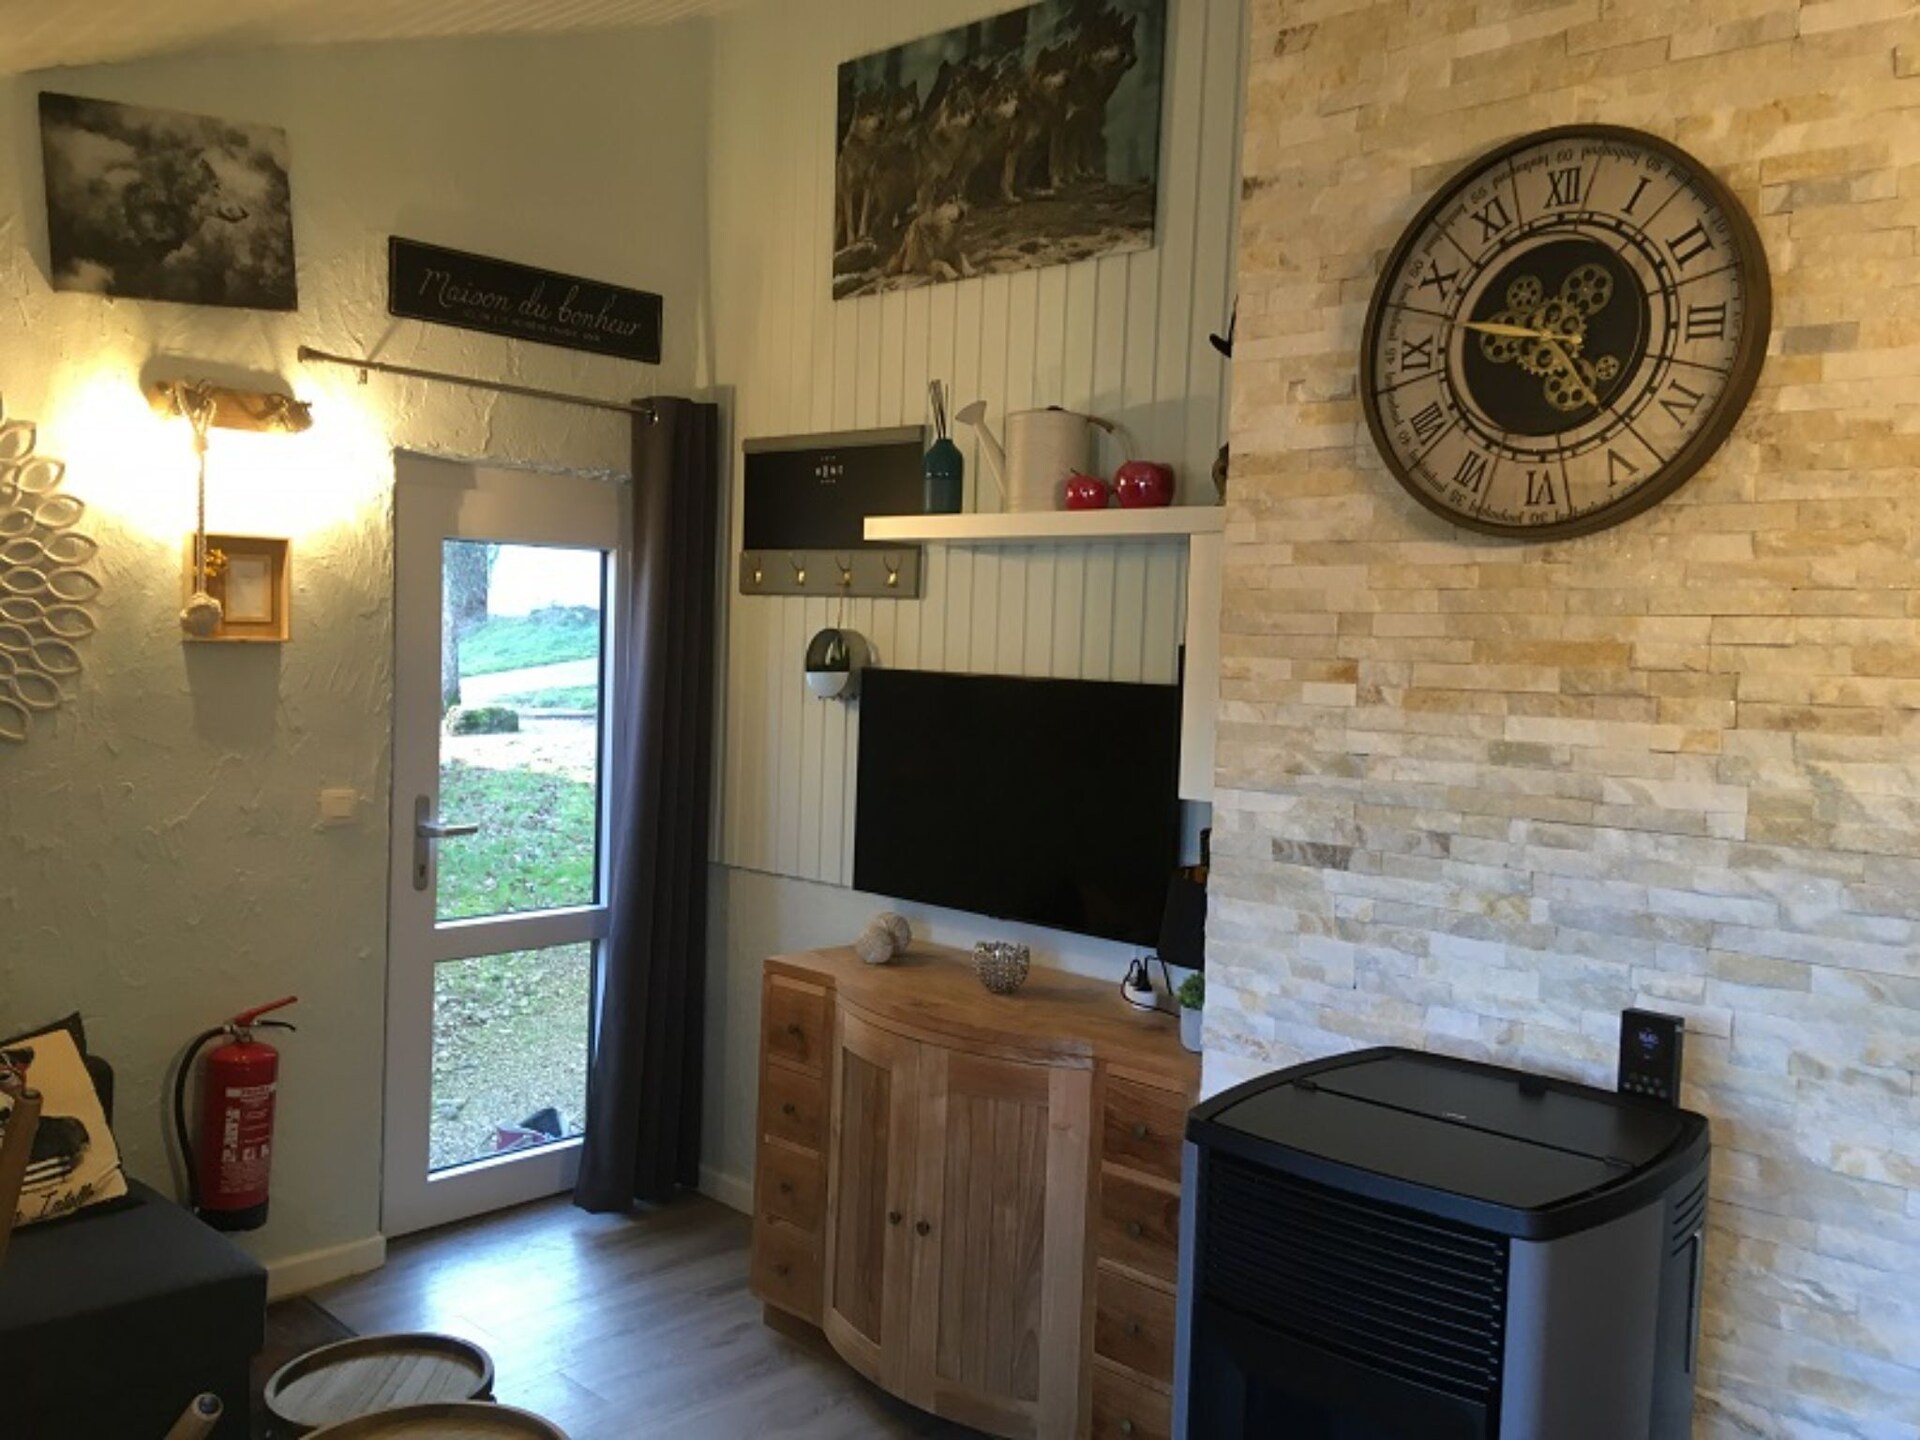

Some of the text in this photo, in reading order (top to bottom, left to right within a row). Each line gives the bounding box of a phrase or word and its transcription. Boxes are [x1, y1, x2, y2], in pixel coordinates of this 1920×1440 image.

[1543, 167, 1581, 209] XII
[1621, 175, 1651, 215] I
[1470, 196, 1513, 244] XI
[1666, 218, 1714, 272] II
[419, 268, 511, 312] Maison
[518, 279, 553, 321] du
[558, 284, 642, 337] bonheur
[1418, 259, 1460, 303] X
[1684, 302, 1727, 343] III
[1401, 336, 1433, 372] IX
[1411, 401, 1447, 446] VIII
[1659, 379, 1705, 429] IV
[1453, 450, 1489, 493] VII
[1524, 470, 1556, 506] VI
[1608, 449, 1640, 487] V
